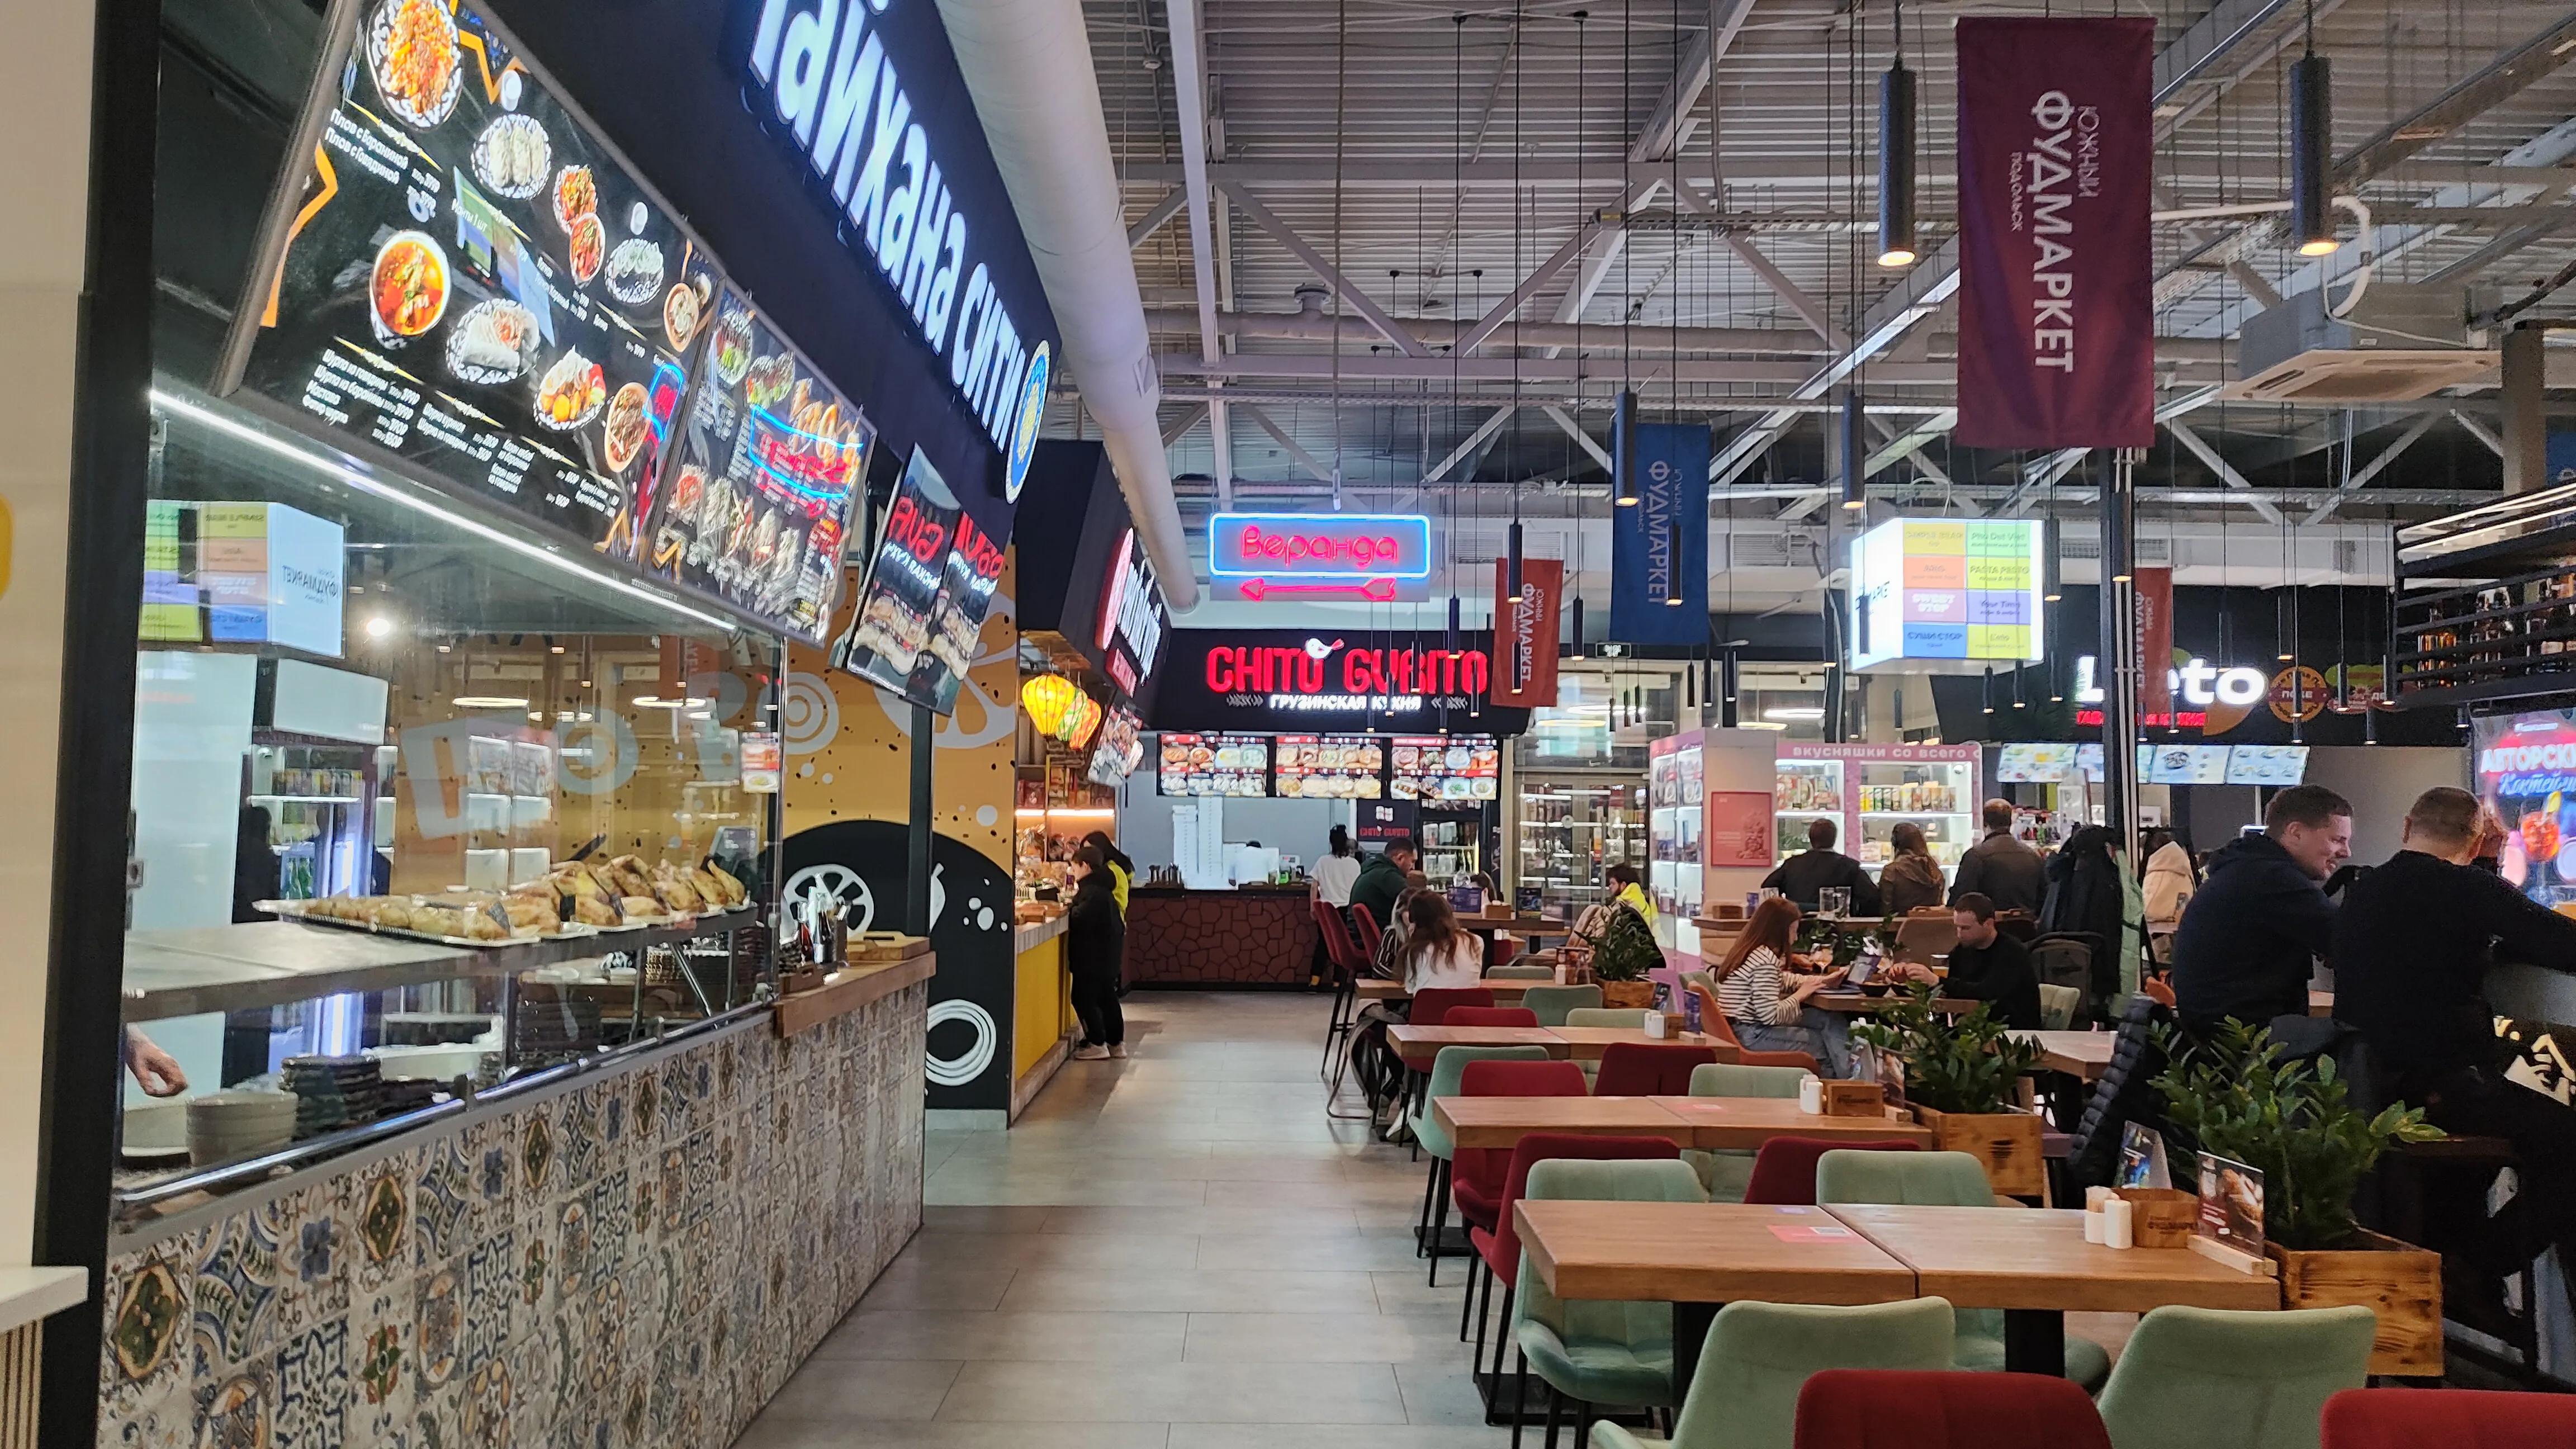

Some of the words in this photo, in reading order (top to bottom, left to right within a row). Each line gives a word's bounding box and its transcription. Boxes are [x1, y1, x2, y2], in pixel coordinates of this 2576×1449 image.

[325, 127, 351, 153] Плов
[330, 108, 357, 135] Плов
[2077, 106, 2101, 198] ЮЖНЫЙ
[2026, 90, 2075, 373] ФУДМАРКЕТ
[1241, 524, 1398, 570] Веранда
[1517, 583, 1536, 682] ФУДМАРКЕТ
[1206, 646, 1325, 693] CHITO
[1343, 647, 1488, 694] GVRITO
[1270, 694, 1367, 711] ГРУЗИНСКАЯ
[1793, 746, 1886, 759] вкусняшки
[1892, 748, 1912, 758] со
[1919, 748, 1966, 759] всего
